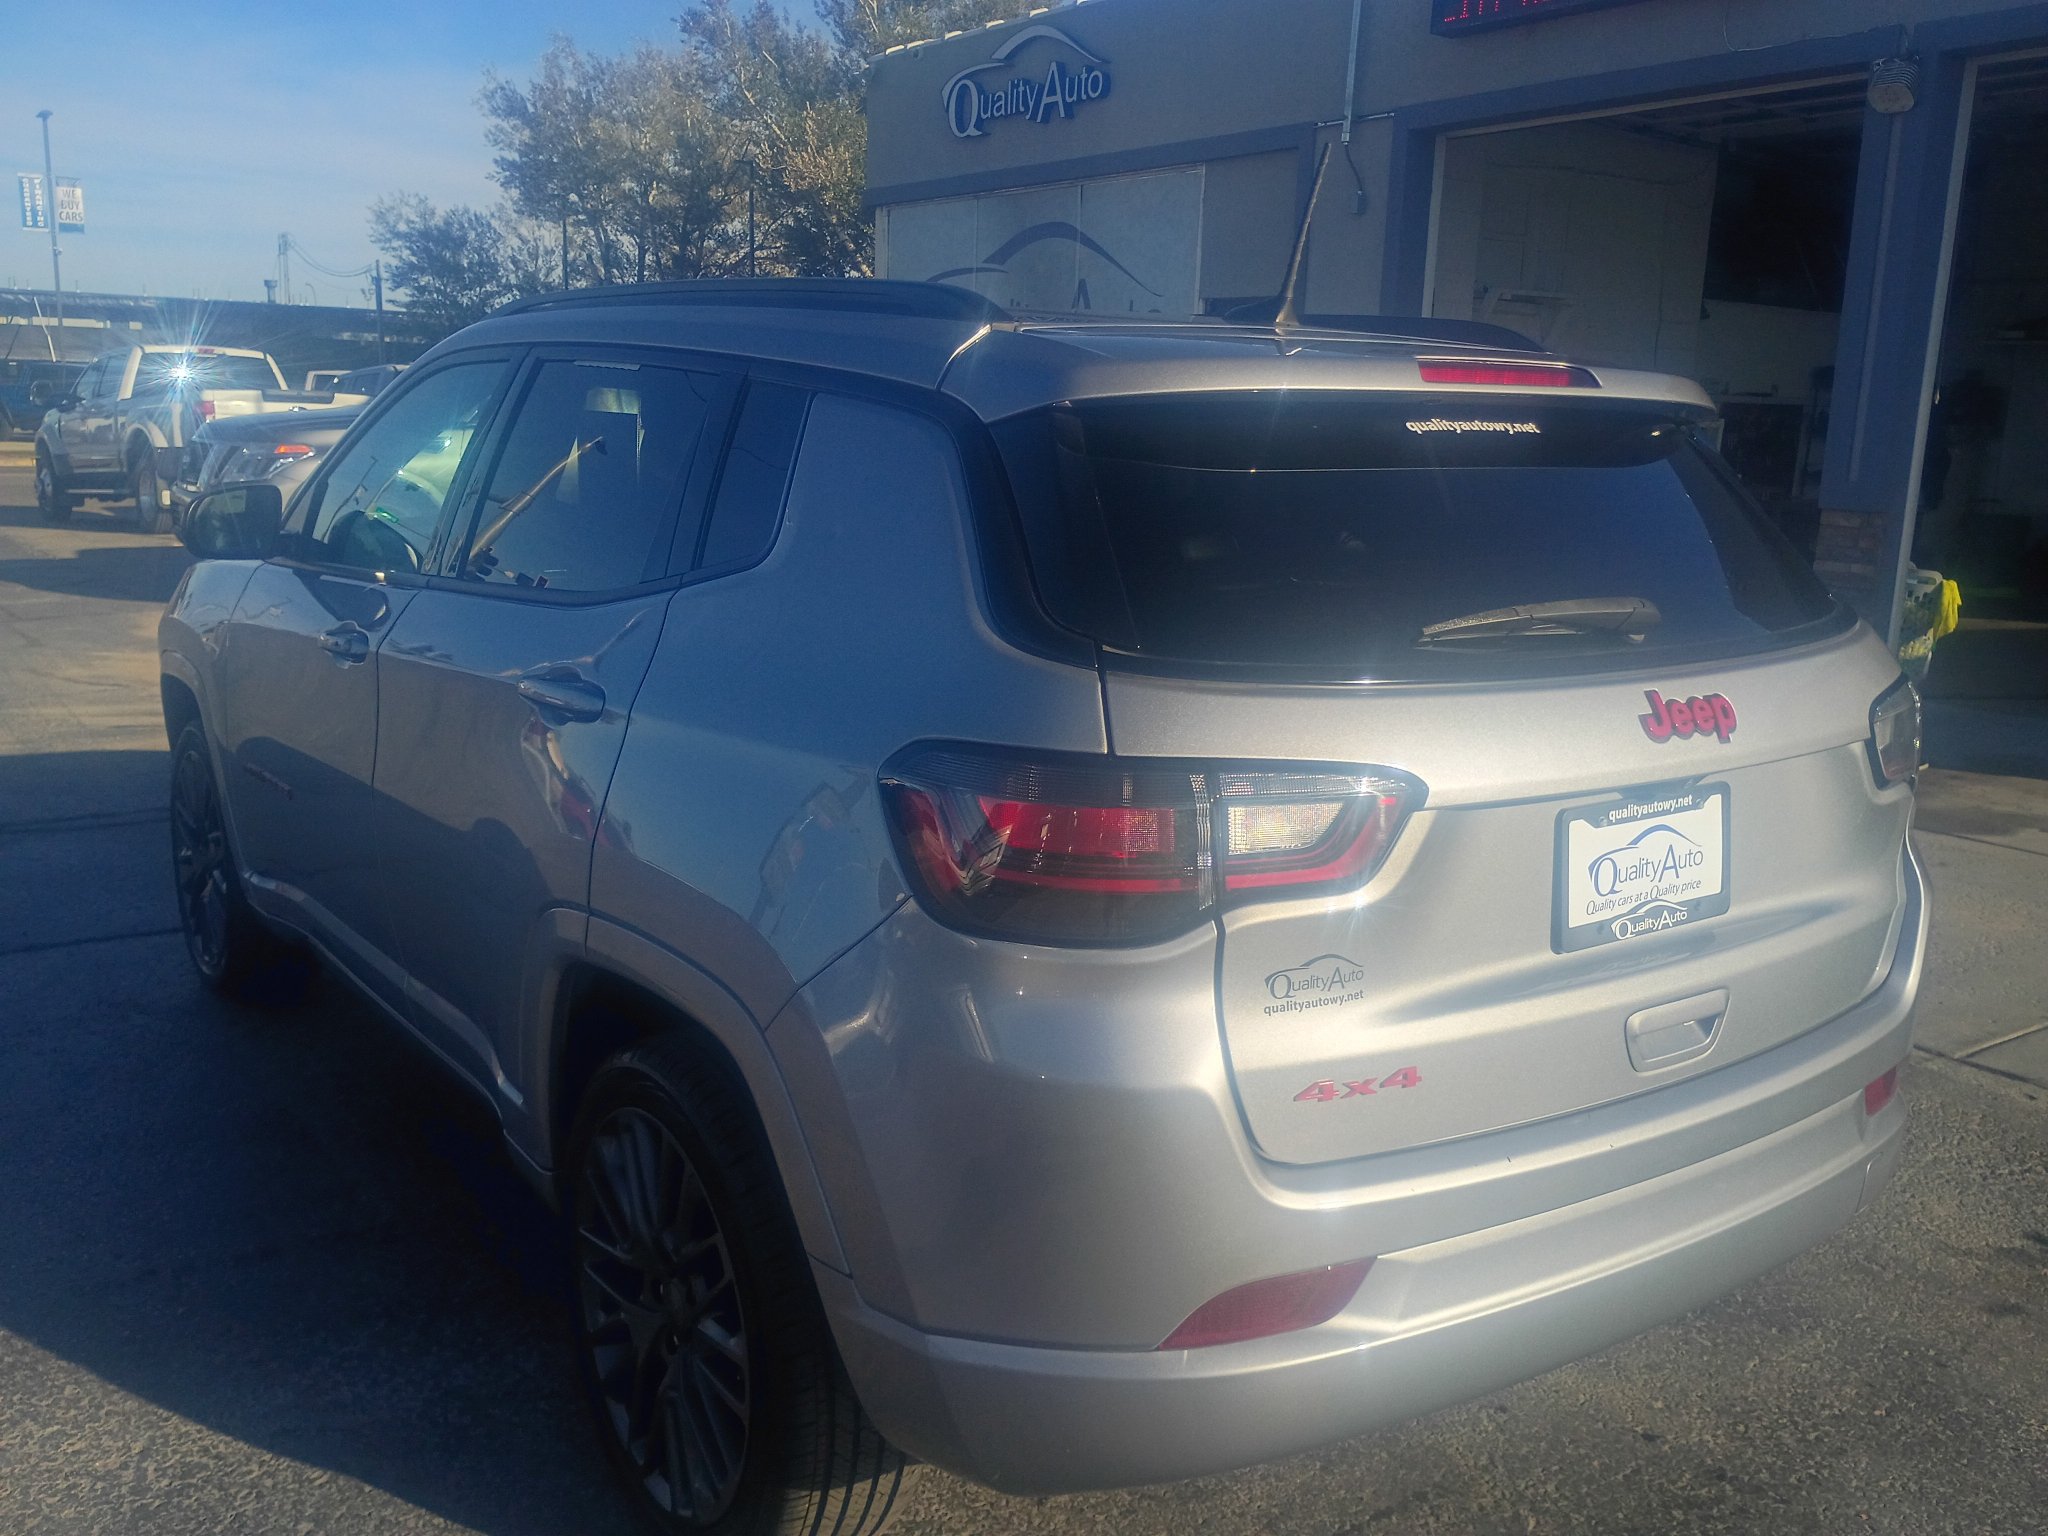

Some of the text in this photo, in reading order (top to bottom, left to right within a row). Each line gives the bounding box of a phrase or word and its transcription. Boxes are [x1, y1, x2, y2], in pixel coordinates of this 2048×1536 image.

[60, 199, 80, 211] BUY
[62, 189, 78, 199] WE
[59, 210, 84, 222] CARS
[1405, 418, 1541, 435] qualityautowy.net
[1638, 688, 1738, 744] Jeep
[1608, 794, 1693, 823] qualityautowy.net
[1586, 900, 1616, 916] Quality
[1617, 895, 1633, 907] cars
[1634, 893, 1642, 903] at
[1649, 883, 1681, 900] Quality
[1680, 879, 1702, 894] price
[1263, 989, 1364, 1016] qualityautowy.net
[1293, 1065, 1422, 1102] 4x4
